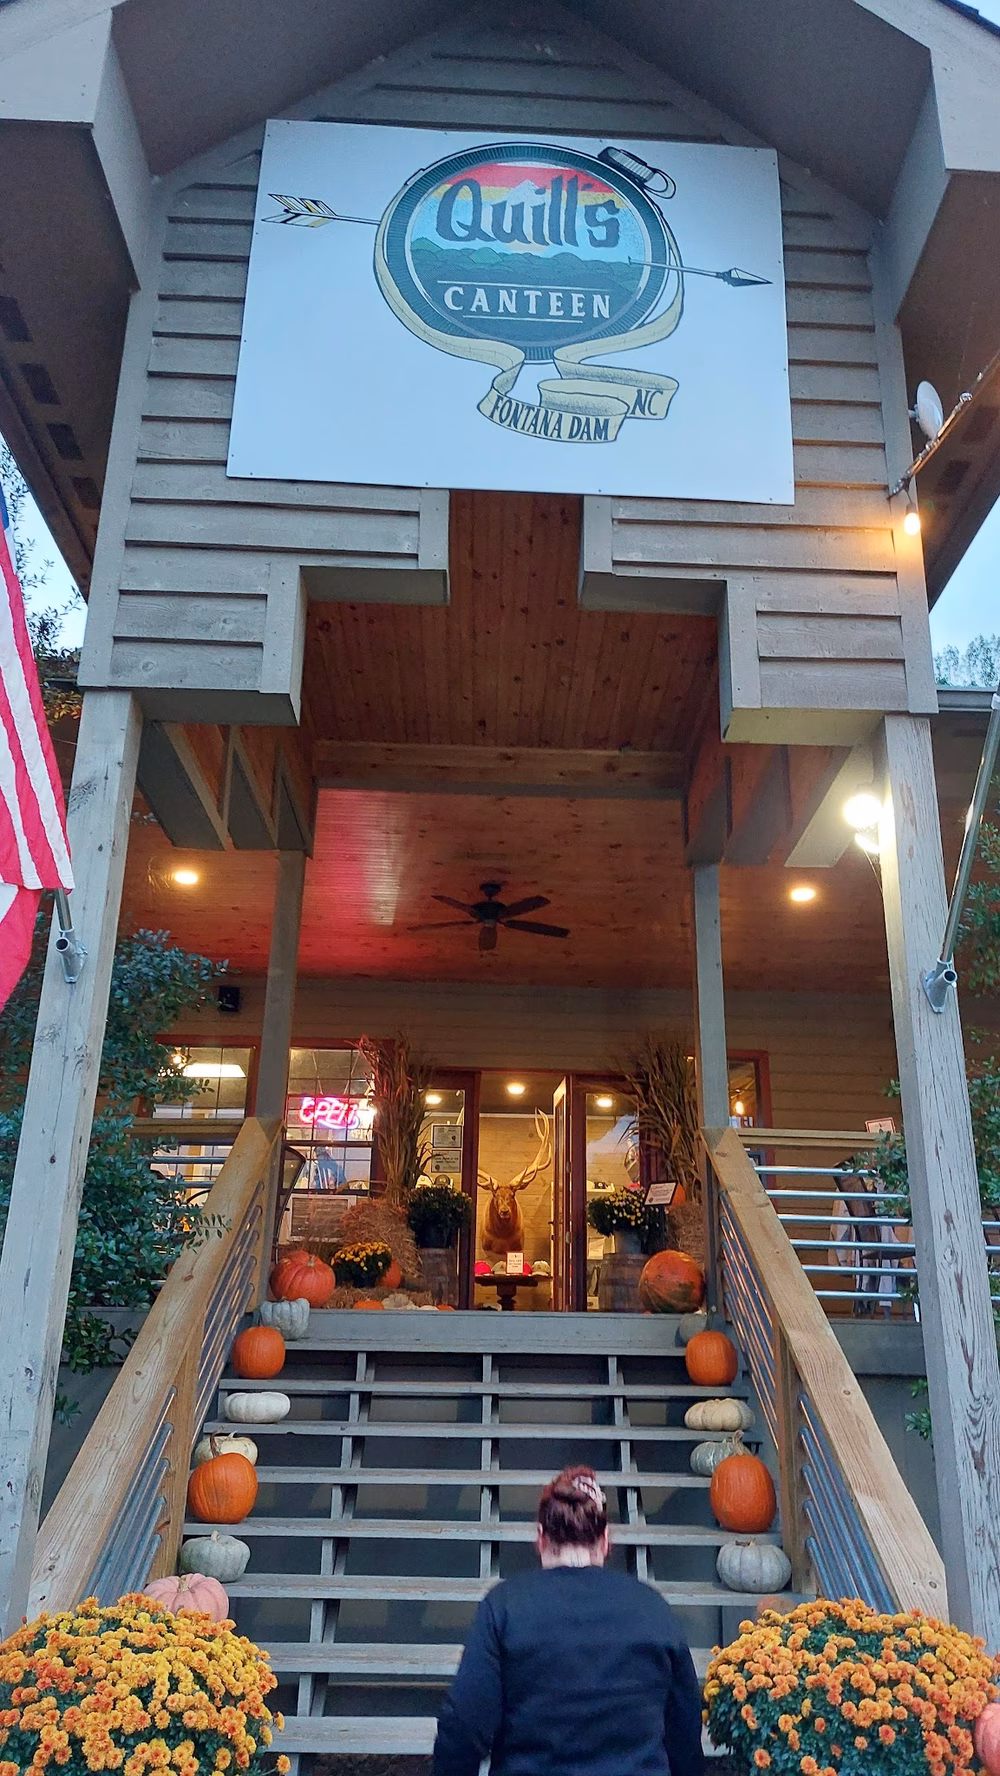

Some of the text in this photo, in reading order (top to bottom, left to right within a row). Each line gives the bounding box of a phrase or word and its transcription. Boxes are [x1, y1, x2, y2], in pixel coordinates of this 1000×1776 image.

[436, 174, 621, 248] Quill's
[443, 286, 611, 319] CANTEEN
[488, 388, 664, 441] FONTANA DAM NC
[300, 1098, 358, 1125] OPEN
